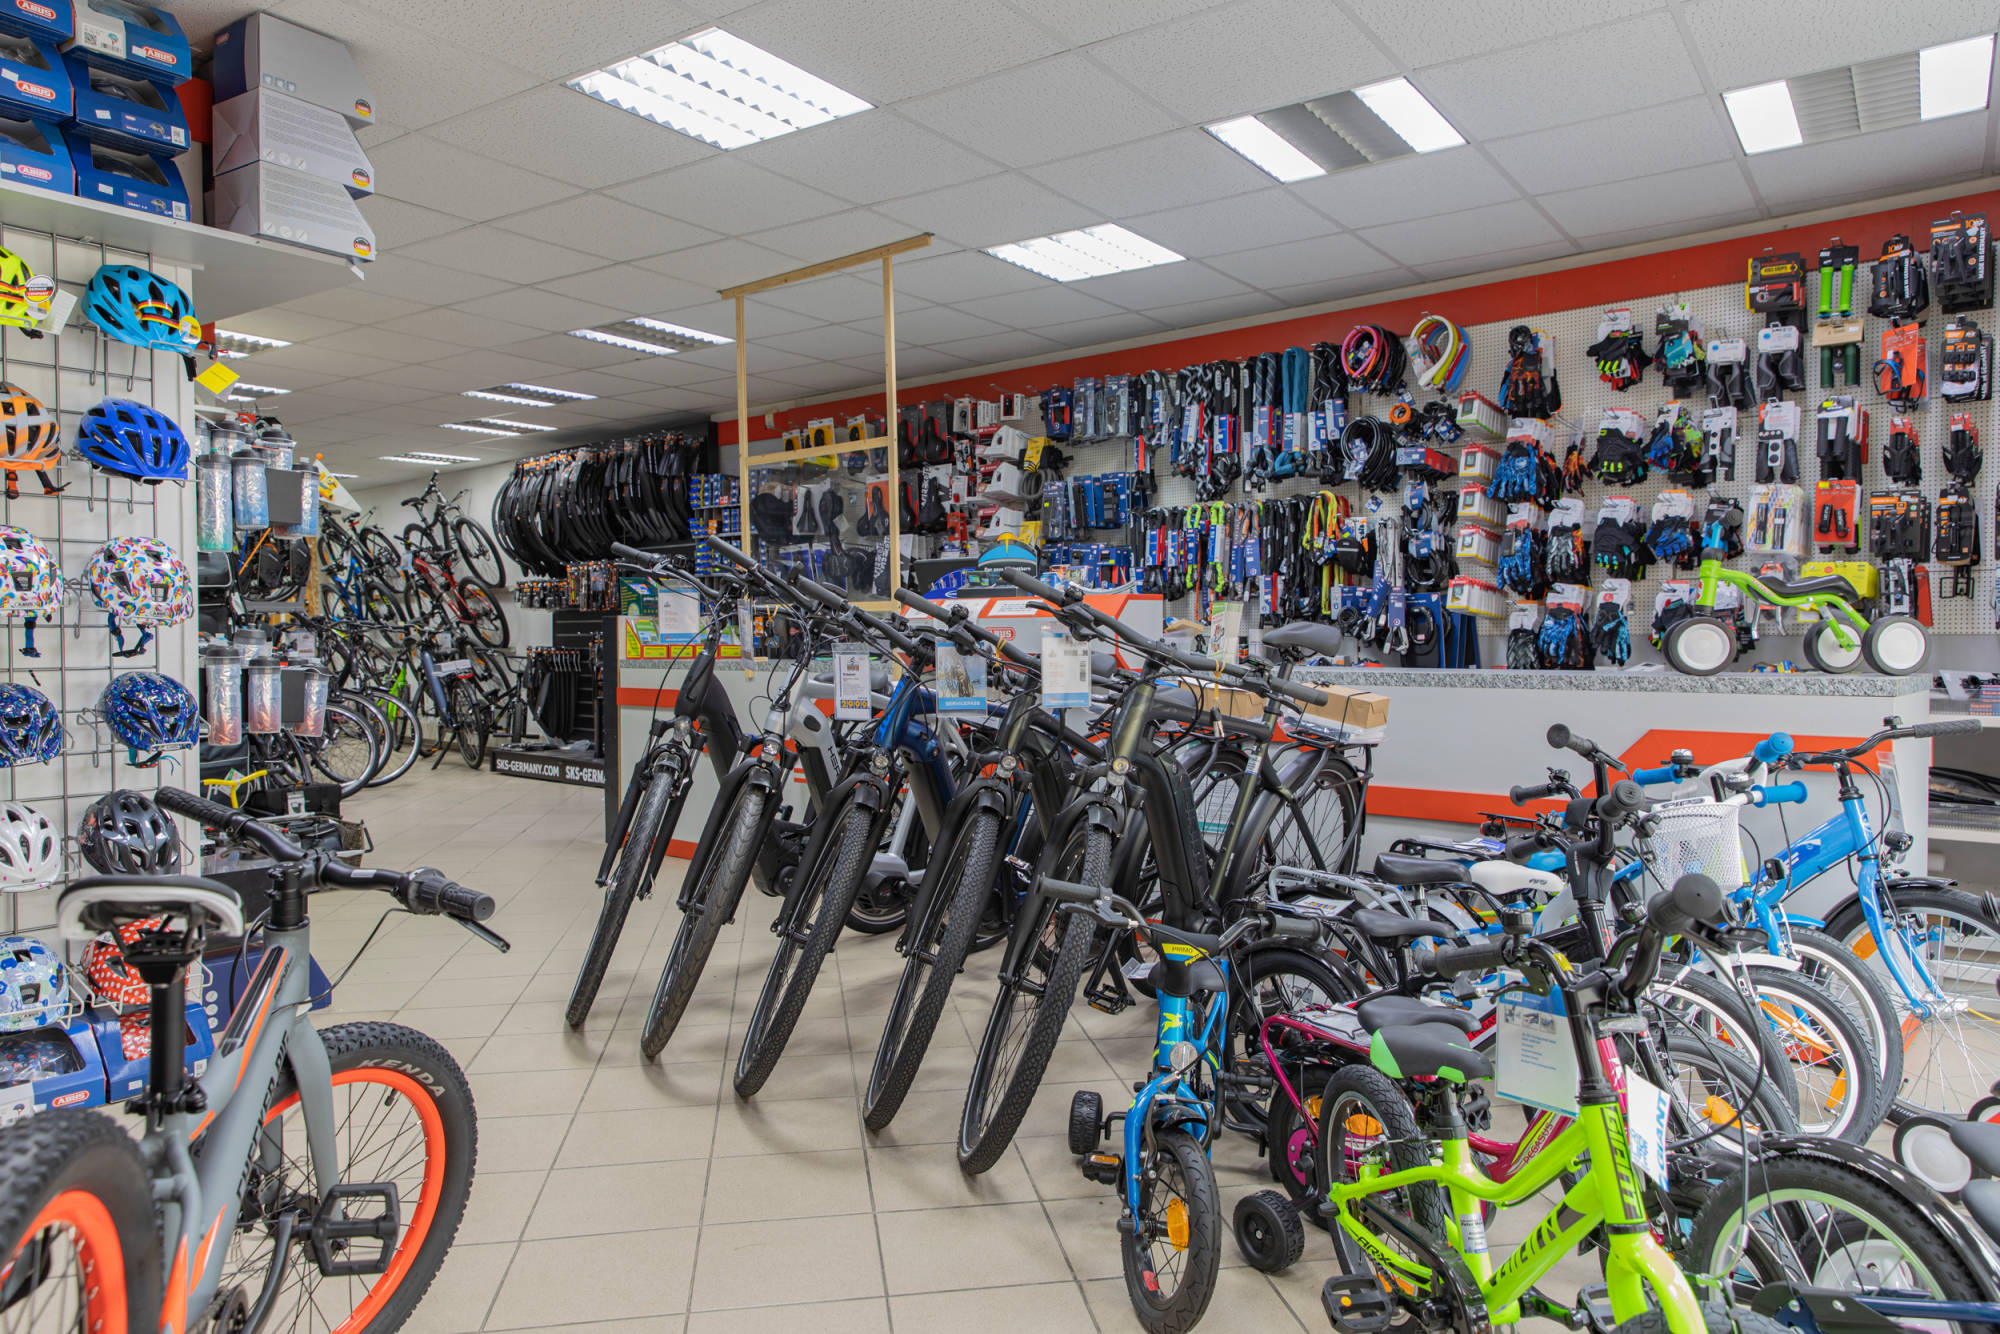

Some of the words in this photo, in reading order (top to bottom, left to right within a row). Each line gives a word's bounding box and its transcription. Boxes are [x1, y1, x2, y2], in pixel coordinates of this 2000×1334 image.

[22, 2, 52, 17] ABUS
[148, 49, 173, 62] ABUS
[21, 83, 51, 97] ABUS
[22, 167, 48, 179] ABUS
[841, 700, 868, 709] 2999
[496, 759, 560, 777] SKS-GERMANY.COM
[359, 1058, 447, 1098] KENDA
[57, 1092, 88, 1105] ABUS
[1655, 1095, 1669, 1168] GIANT
[1523, 1122, 1554, 1164] PEGASUS
[1603, 1106, 1637, 1208] GIANT
[1358, 1235, 1391, 1264] ARX
